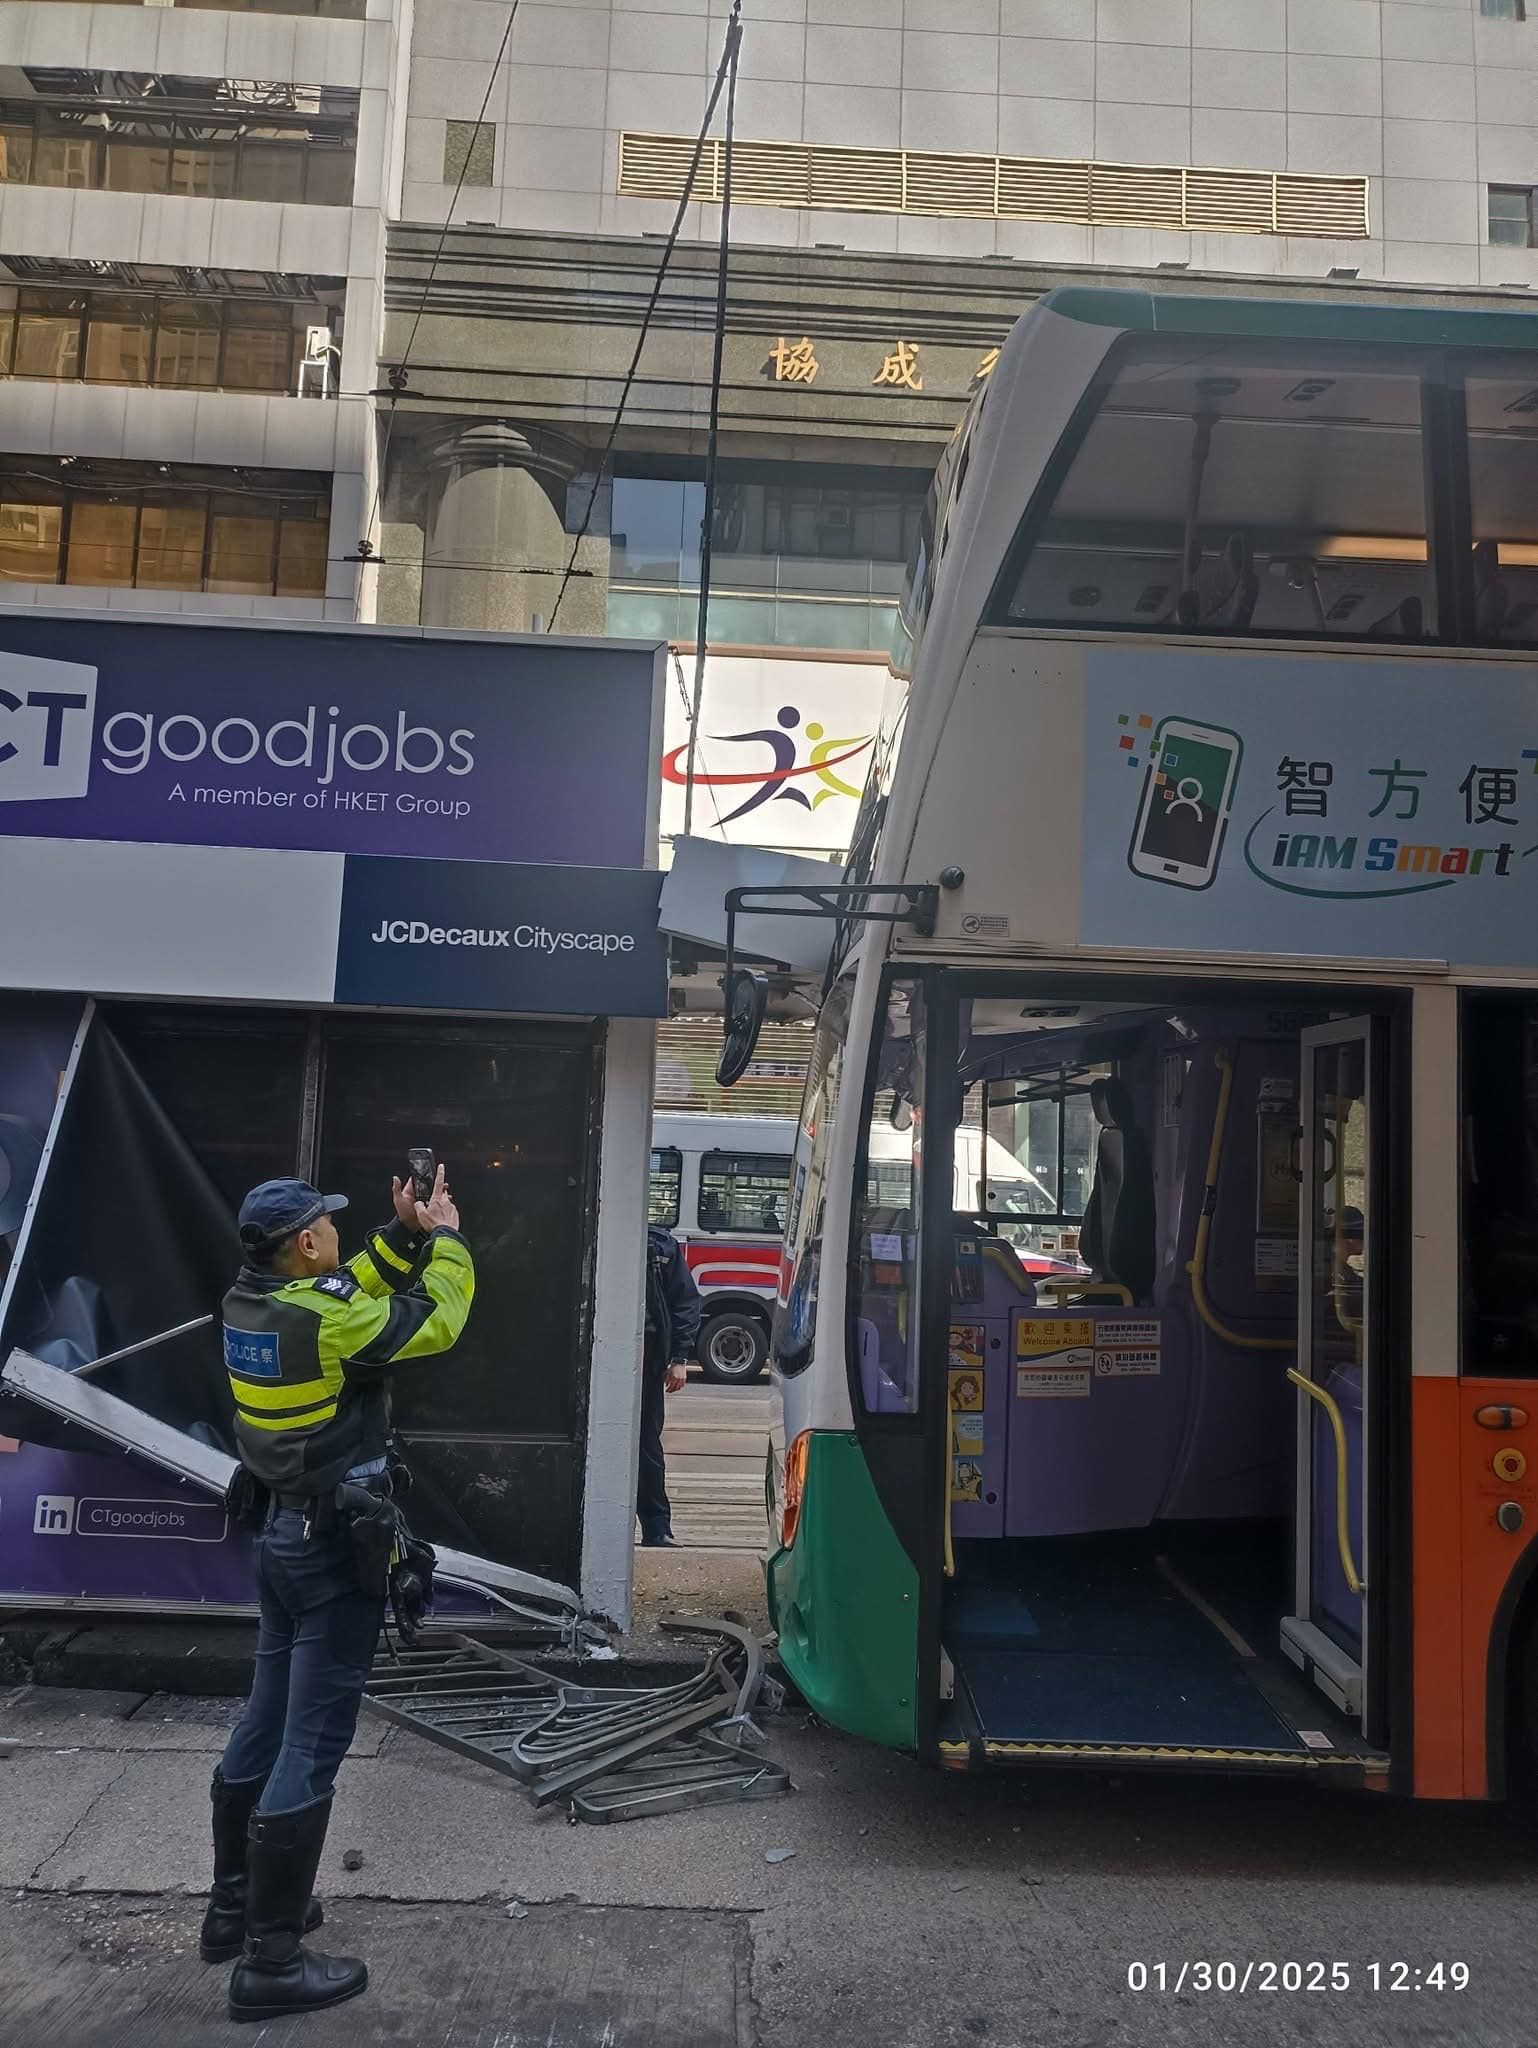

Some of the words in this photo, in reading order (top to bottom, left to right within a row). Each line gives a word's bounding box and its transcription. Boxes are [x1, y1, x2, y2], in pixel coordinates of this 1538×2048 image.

[769, 336, 999, 390] 協成
[168, 783, 189, 803] A
[194, 786, 295, 809] member
[303, 789, 328, 810] of
[334, 791, 389, 813] HKET
[395, 793, 472, 820] Group
[1277, 755, 1519, 826] 智方便
[1272, 833, 1358, 870] iAM
[1364, 837, 1515, 877] Smart
[371, 920, 510, 948] JCDecaux
[513, 924, 635, 956] Cityscape
[1023, 1336, 1061, 1346] Welcome
[1062, 1336, 1090, 1346] Aboard
[39, 1500, 68, 1529] in
[90, 1508, 186, 1528] CTgoodjobs
